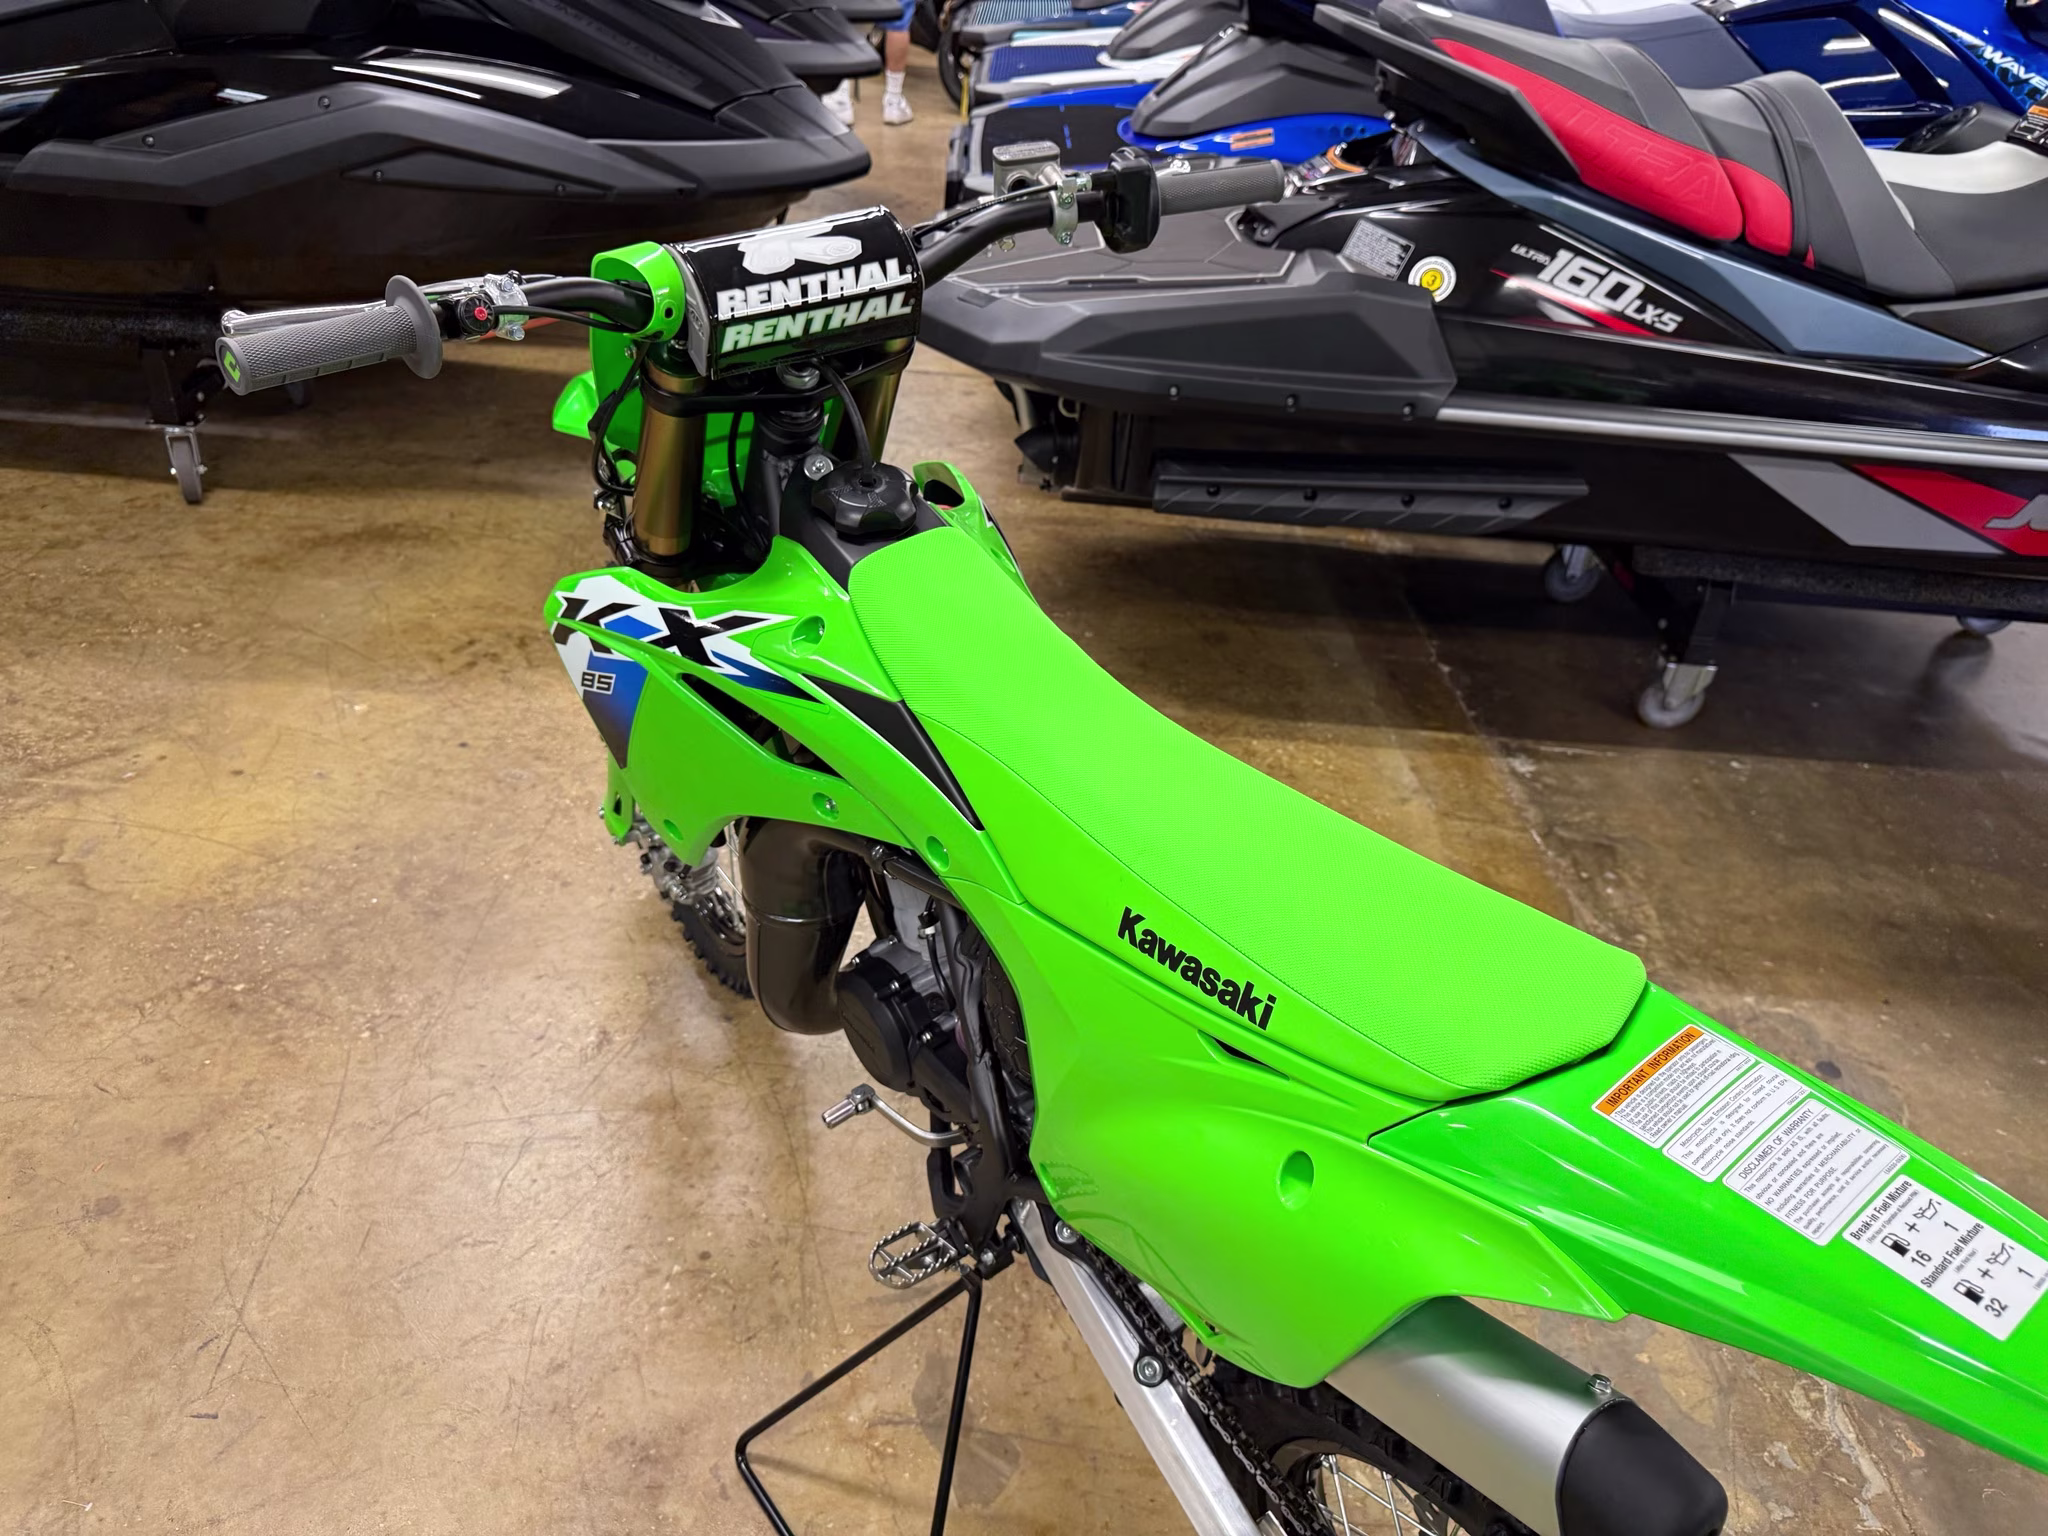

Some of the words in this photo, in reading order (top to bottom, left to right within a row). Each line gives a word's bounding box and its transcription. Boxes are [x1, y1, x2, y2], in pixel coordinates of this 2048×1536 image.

[716, 257, 913, 320] RENTHAL
[1537, 248, 1645, 312] 160
[721, 291, 913, 353] RENTHAL
[581, 671, 615, 691] 85
[1118, 906, 1277, 1031] Kawasaki
[1604, 1069, 1650, 1107] IMPORTANT
[1647, 1031, 1696, 1070] INFORMATION
[1681, 1150, 1693, 1159] This
[1694, 1127, 1718, 1147] motorcycle
[1724, 1103, 1744, 1119] designed
[1701, 1116, 1714, 1127] Noise
[1737, 1145, 1776, 1179] DISCLAIMER
[1772, 1135, 1784, 1145] OF
[1781, 1108, 1814, 1136] WARRANTY
[1690, 1143, 1716, 1166] competition
[1699, 1149, 1725, 1171] motorcycle
[1744, 1182, 1756, 1192] This
[1754, 1161, 1778, 1183] motorcycle
[1780, 1147, 1792, 1156] sold
[1755, 1183, 1772, 1199] obvious
[1776, 1157, 1798, 1177] concealed
[1774, 1193, 1796, 1212] including
[1818, 1132, 1855, 1167] MERCHANTABILITY
[1764, 1197, 1774, 1206] NO
[1772, 1168, 1803, 1197] WARRANTIES
[1784, 1198, 1806, 1219] FITNESS
[1804, 1188, 1816, 1199] FOR
[1849, 1213, 1880, 1240] Break-in
[1873, 1199, 1892, 1215] Fuel
[1885, 1180, 1912, 1203] Mixture
[1909, 1249, 1932, 1268] 16
[1942, 1221, 1959, 1232] 1
[1919, 1256, 1953, 1288] Standard
[1945, 1243, 1964, 1260] Fuel
[1957, 1222, 1984, 1246] Mixture
[1983, 1297, 2008, 1317] 32
[2016, 1266, 2034, 1278] 1
